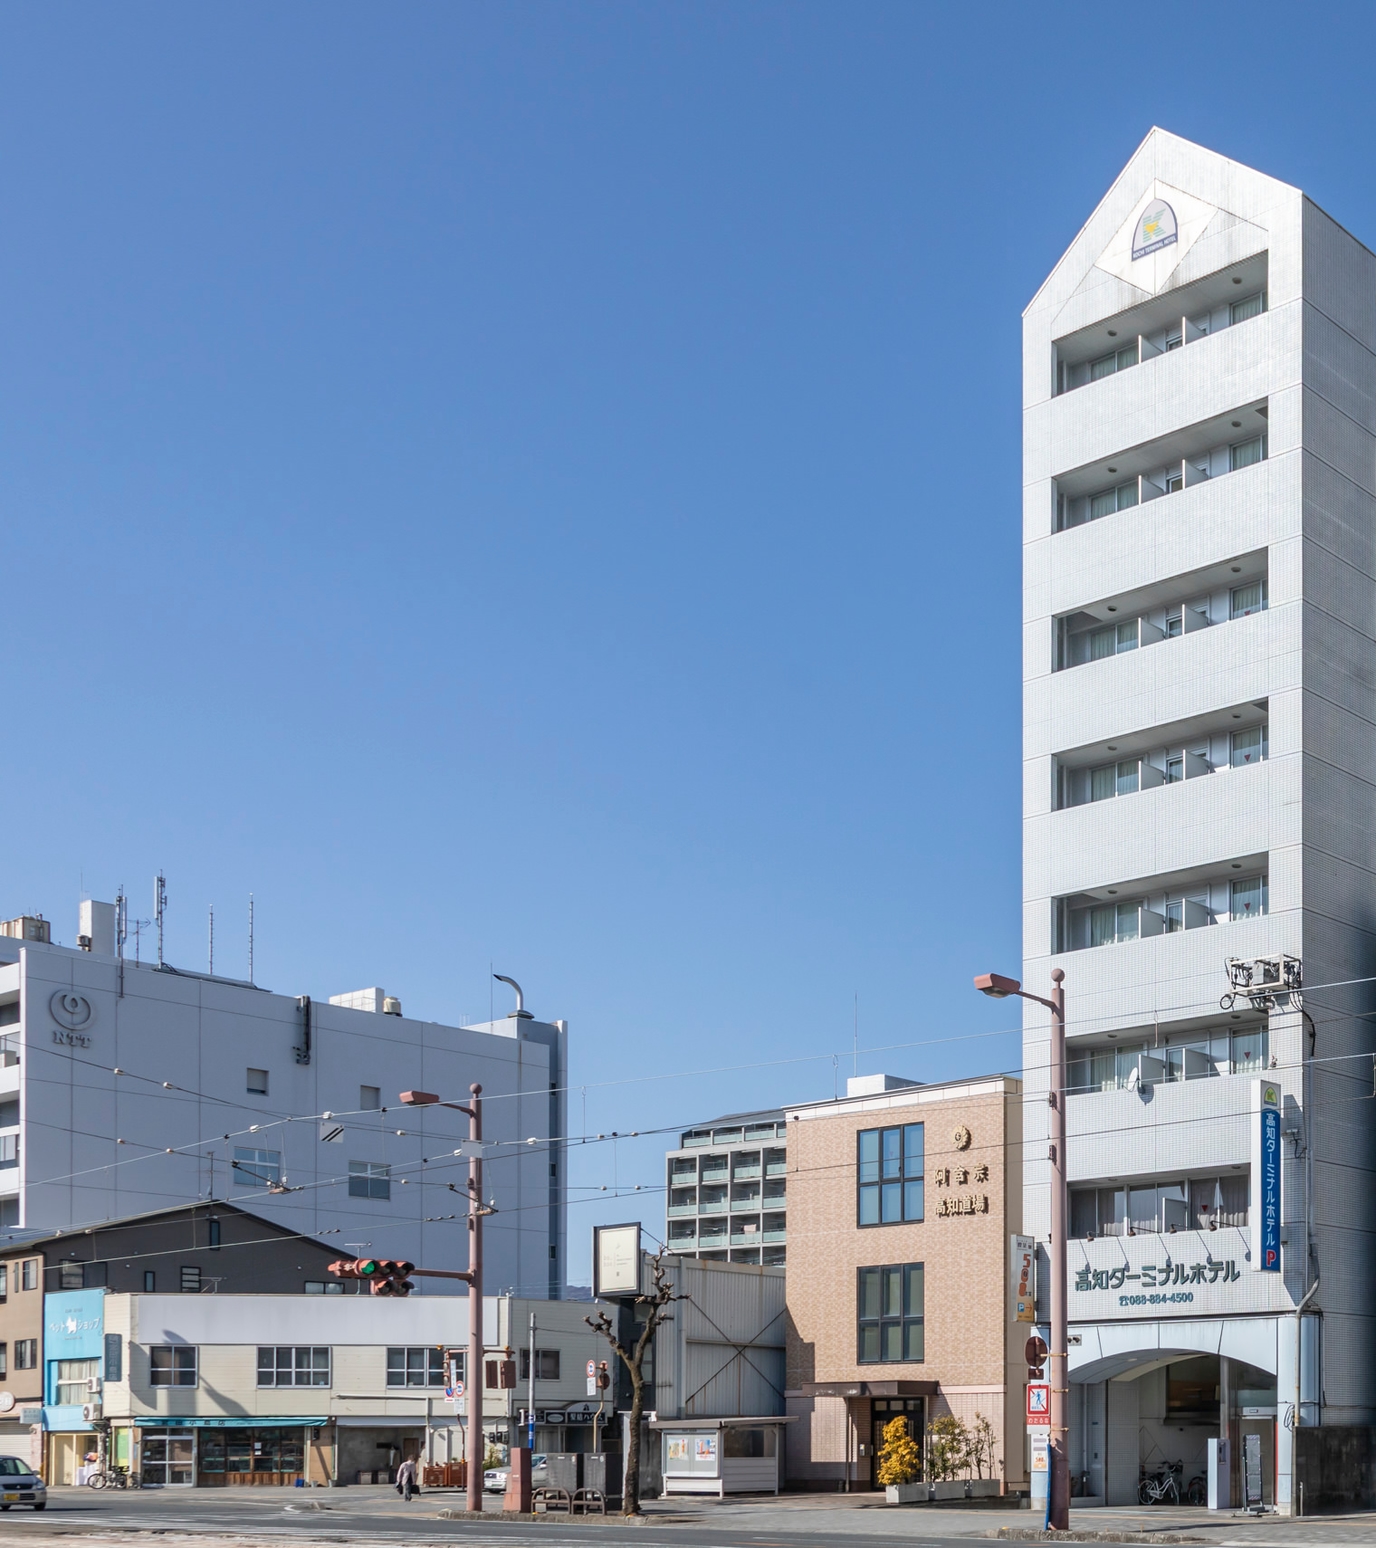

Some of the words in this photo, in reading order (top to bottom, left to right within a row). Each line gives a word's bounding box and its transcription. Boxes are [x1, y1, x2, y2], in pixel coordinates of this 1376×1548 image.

[53, 1030, 92, 1049] NTT
[1266, 1112, 1276, 1247] 高知ターミナルホテル
[936, 1194, 988, 1215] 高知道場
[1266, 1249, 1276, 1267] P
[1075, 1260, 1241, 1291] 高知ターミナルホテル
[78, 1316, 101, 1330] ショップ
